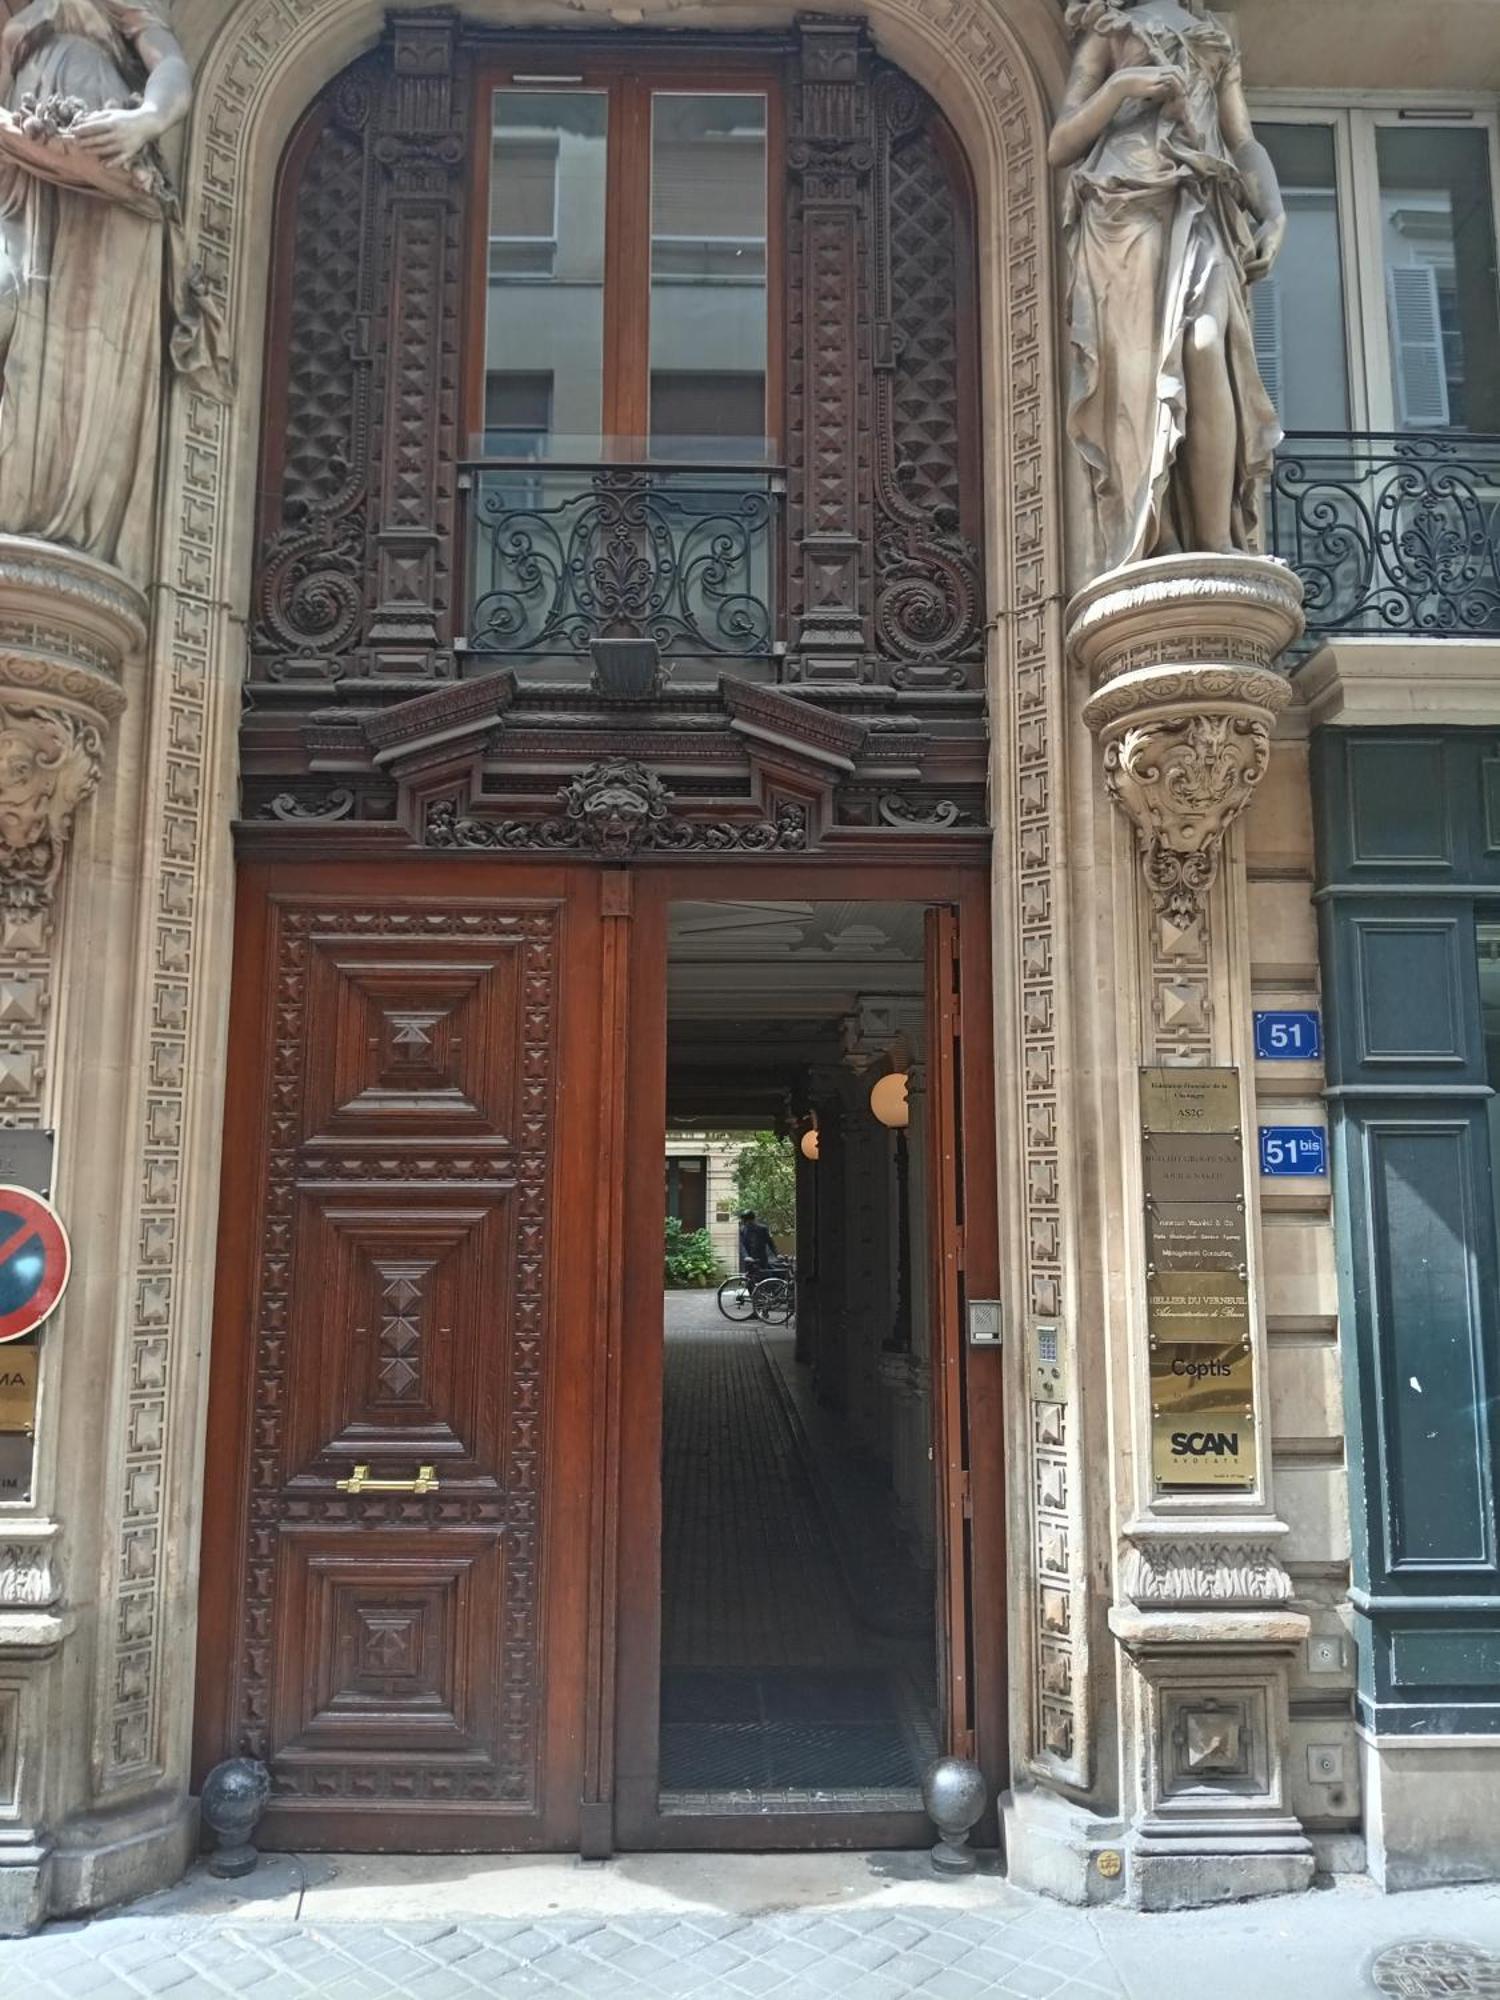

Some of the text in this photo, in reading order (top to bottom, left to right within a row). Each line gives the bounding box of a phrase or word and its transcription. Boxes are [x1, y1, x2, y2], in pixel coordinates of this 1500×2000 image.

[1271, 1023, 1301, 1047] 51
[1188, 1296, 1200, 1305] DU
[1203, 1296, 1247, 1305] VERNEUIL
[1171, 1358, 1231, 1380] Coptis
[1171, 1432, 1239, 1455] SCAN
